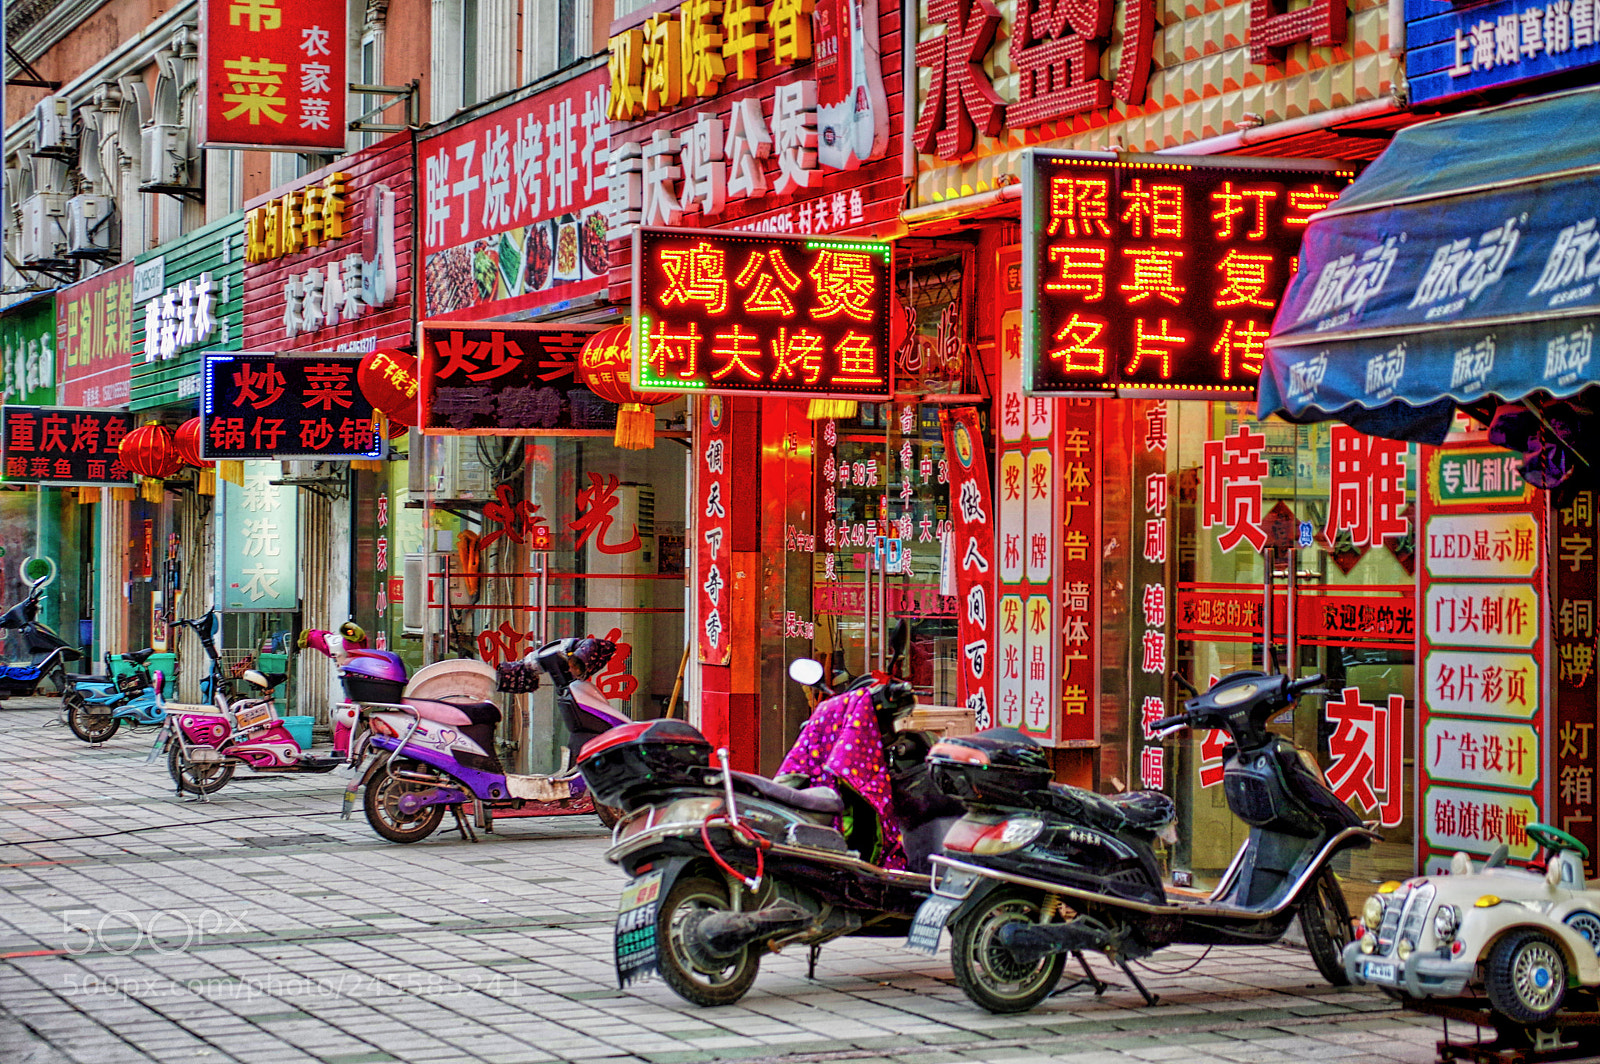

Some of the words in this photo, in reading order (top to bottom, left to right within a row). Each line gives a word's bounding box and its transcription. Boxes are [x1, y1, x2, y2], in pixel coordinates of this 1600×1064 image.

[300, 25, 331, 131] 农家菜
[1449, 0, 1600, 77] 上海烟草销售
[607, 80, 821, 241] 重庆鸡公煲
[799, 190, 864, 234] 村夫烤鱼
[1047, 176, 1184, 240] 照相
[283, 253, 366, 337] 农家小菜
[660, 242, 875, 321] 鸡公煲
[1045, 246, 1186, 306] 写真
[1297, 237, 1399, 321] 脉动
[1407, 217, 1520, 309] 脉动
[67, 275, 132, 367] 巴渝川菜馆
[144, 272, 217, 362] 雅森洗衣
[649, 321, 883, 383] 村夫烤鱼
[1047, 313, 1186, 379] 名片
[1544, 325, 1593, 379] 脉动
[232, 363, 354, 410] 炒菜
[435, 331, 594, 383] 炒菜
[1287, 351, 1328, 399] 脉动
[1365, 343, 1406, 394] 脉动
[1451, 336, 1496, 388] 脉动
[6, 456, 73, 478] 酸菜鱼
[86, 459, 129, 480] 面条
[8, 413, 127, 454] 重庆烤鱼
[210, 416, 287, 450] 锅仔
[299, 417, 374, 450] 砂锅
[1064, 428, 1091, 562] 车体广告
[1442, 457, 1523, 493] 专业制作
[239, 460, 281, 602] 森洗衣
[704, 439, 726, 650] 调天下奇香
[1003, 465, 1020, 569] 奖杯
[1031, 463, 1048, 568] 奖牌
[1143, 473, 1167, 562] 印刷
[1429, 529, 1534, 563] LED显示屏
[958, 478, 989, 731] 做人间百味
[1142, 583, 1165, 674] 锦旗
[1435, 596, 1528, 637] 门头制作
[1559, 599, 1594, 680] 铜牌
[1003, 599, 1020, 725] 发光字
[1030, 599, 1047, 727] 水晶字
[1062, 581, 1090, 716] 墙体广告
[1435, 663, 1528, 707] 名片彩页
[1140, 696, 1165, 790] 横幅
[1434, 729, 1528, 776] 广告设计
[1434, 799, 1529, 847] 锦旗横幅
[1559, 720, 1594, 878] 灯箱广
